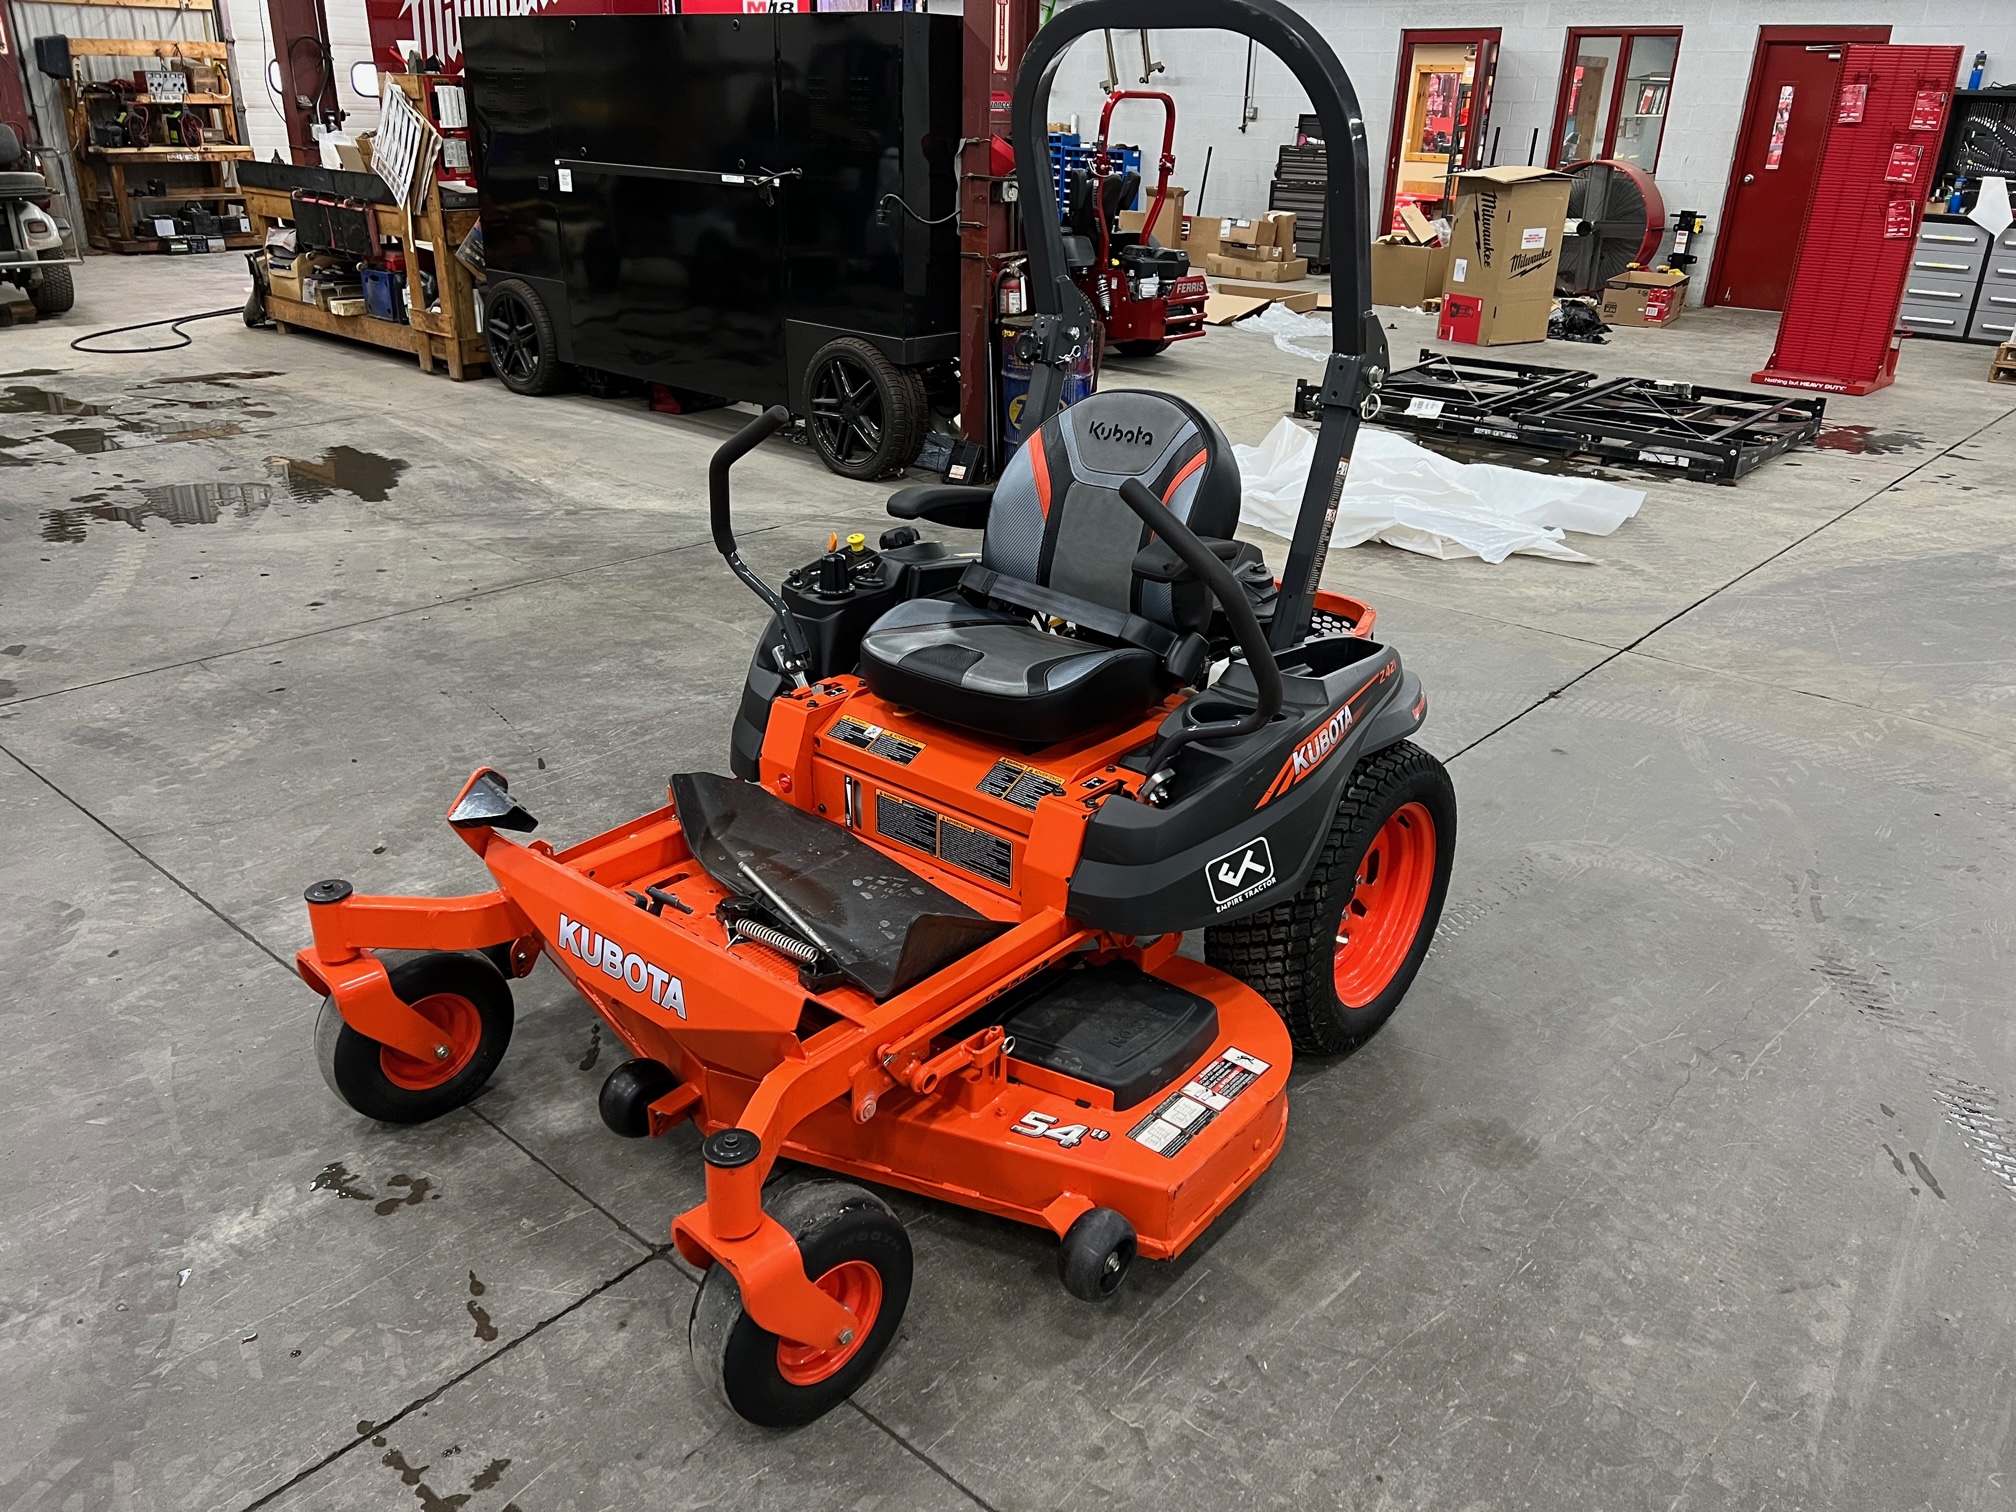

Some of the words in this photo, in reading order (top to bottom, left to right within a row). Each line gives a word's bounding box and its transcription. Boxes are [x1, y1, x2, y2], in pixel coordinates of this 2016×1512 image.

[1480, 188, 1498, 268] Milwaukee
[1509, 249, 1553, 273] Milwaukee
[1176, 281, 1204, 293] FERRIS
[1764, 376, 1787, 386] Nothing
[1800, 381, 1824, 389] HEAVY
[1089, 421, 1153, 445] Kubota
[1292, 704, 1354, 776] KUBOTA
[1215, 895, 1244, 913] EMPIRE
[1244, 876, 1277, 899] TRACTOR
[558, 912, 687, 1021] KUBOTA
